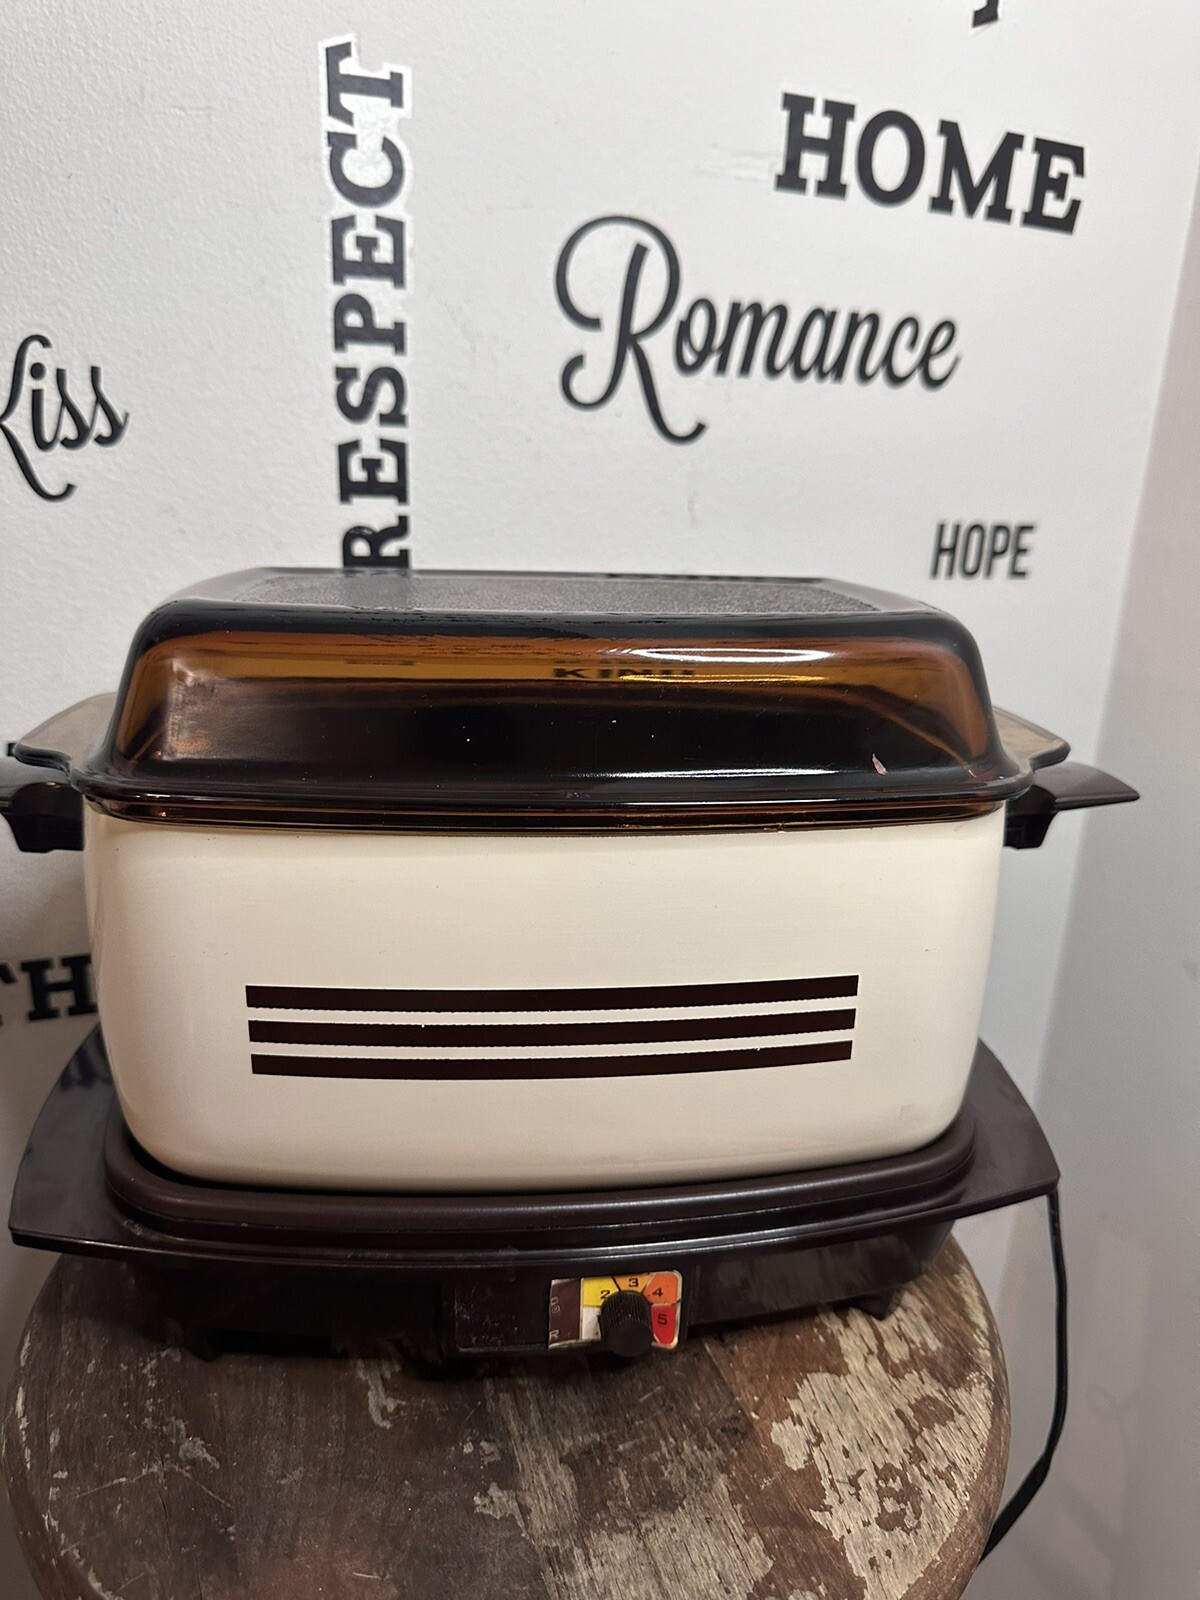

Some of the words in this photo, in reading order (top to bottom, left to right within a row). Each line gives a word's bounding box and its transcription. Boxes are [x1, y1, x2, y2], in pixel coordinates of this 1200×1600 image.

[776, 92, 1086, 235] HOME
[325, 42, 411, 570] RESPECT
[555, 215, 961, 445] Romance
[931, 523, 1036, 578] HOPE
[600, 1289, 610, 1299] 2
[628, 1278, 638, 1287] 3
[652, 1288, 663, 1296] 4
[658, 1313, 667, 1325] 5
